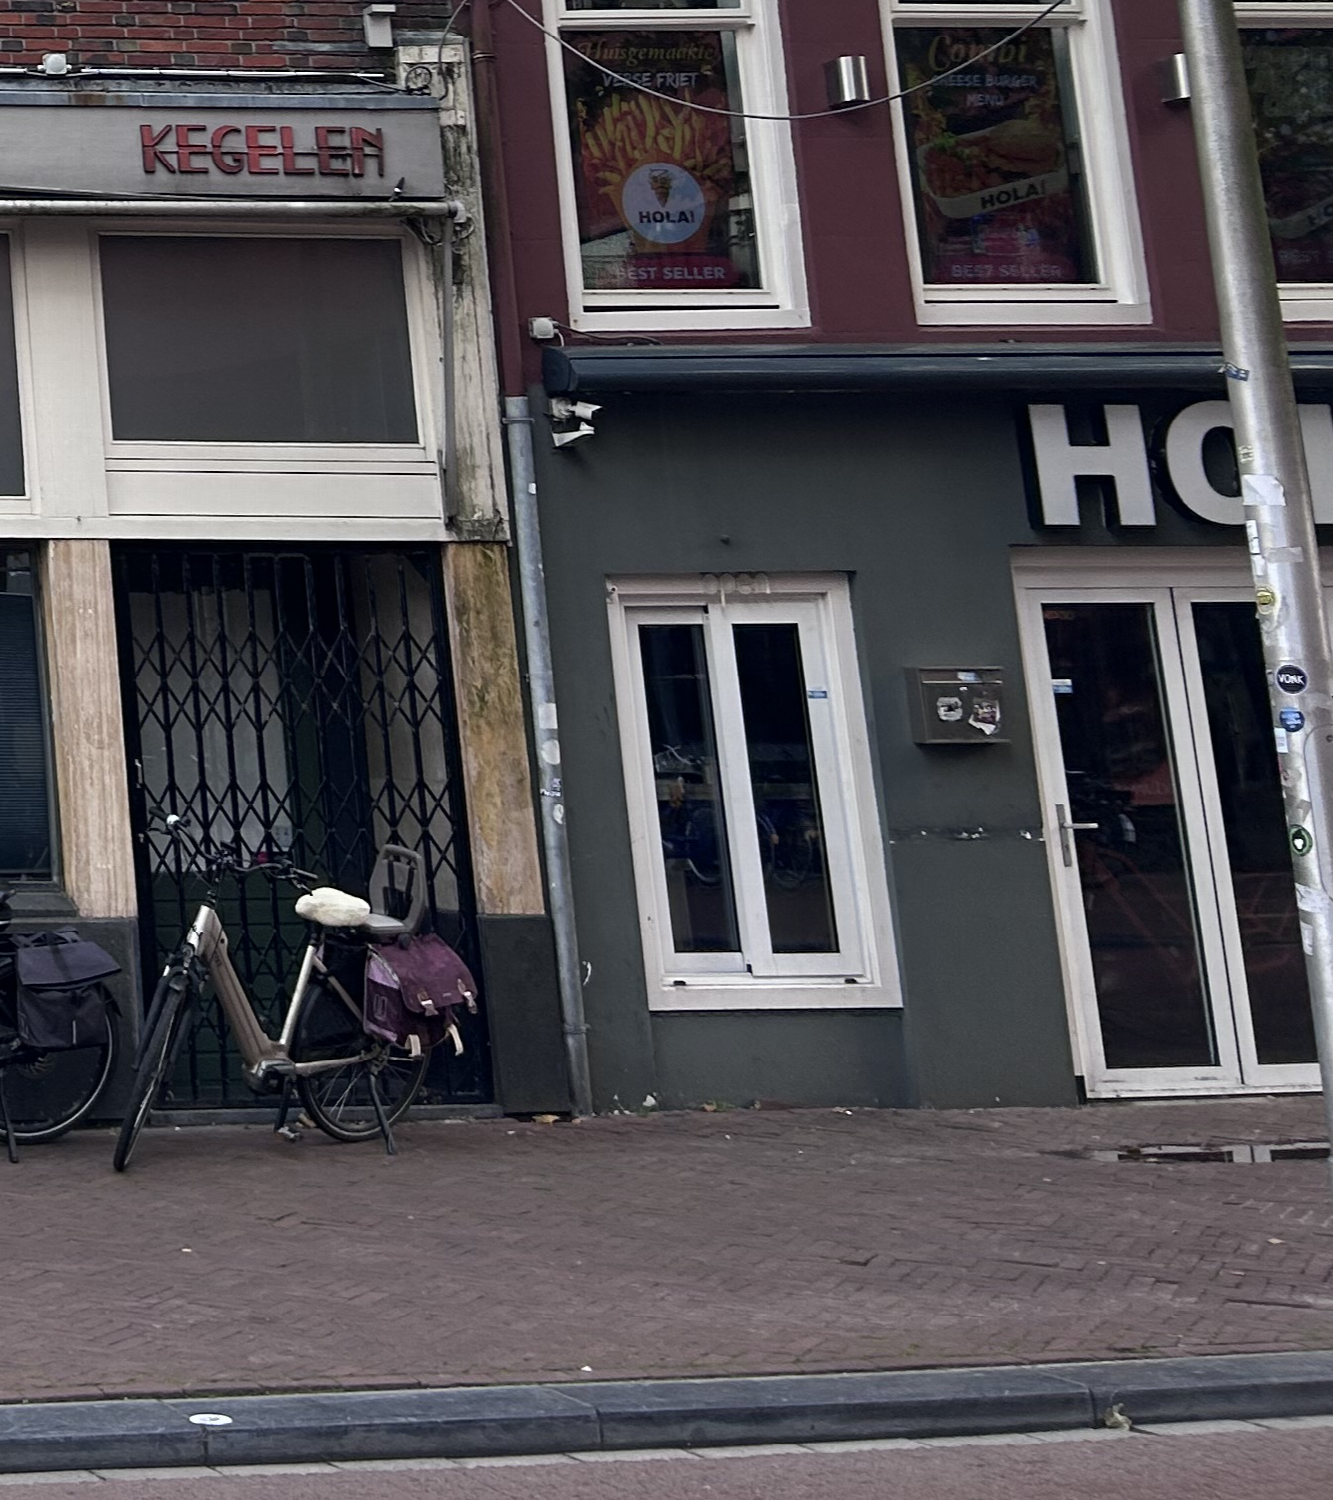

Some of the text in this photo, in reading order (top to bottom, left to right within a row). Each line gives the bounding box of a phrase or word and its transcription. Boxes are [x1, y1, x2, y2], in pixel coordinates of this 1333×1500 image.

[601, 72, 652, 88] VERSE
[985, 74, 1039, 88] BURGER
[140, 123, 385, 178] KEGELEN
[639, 210, 696, 224] HOLA!
[662, 266, 726, 280] SELLER
